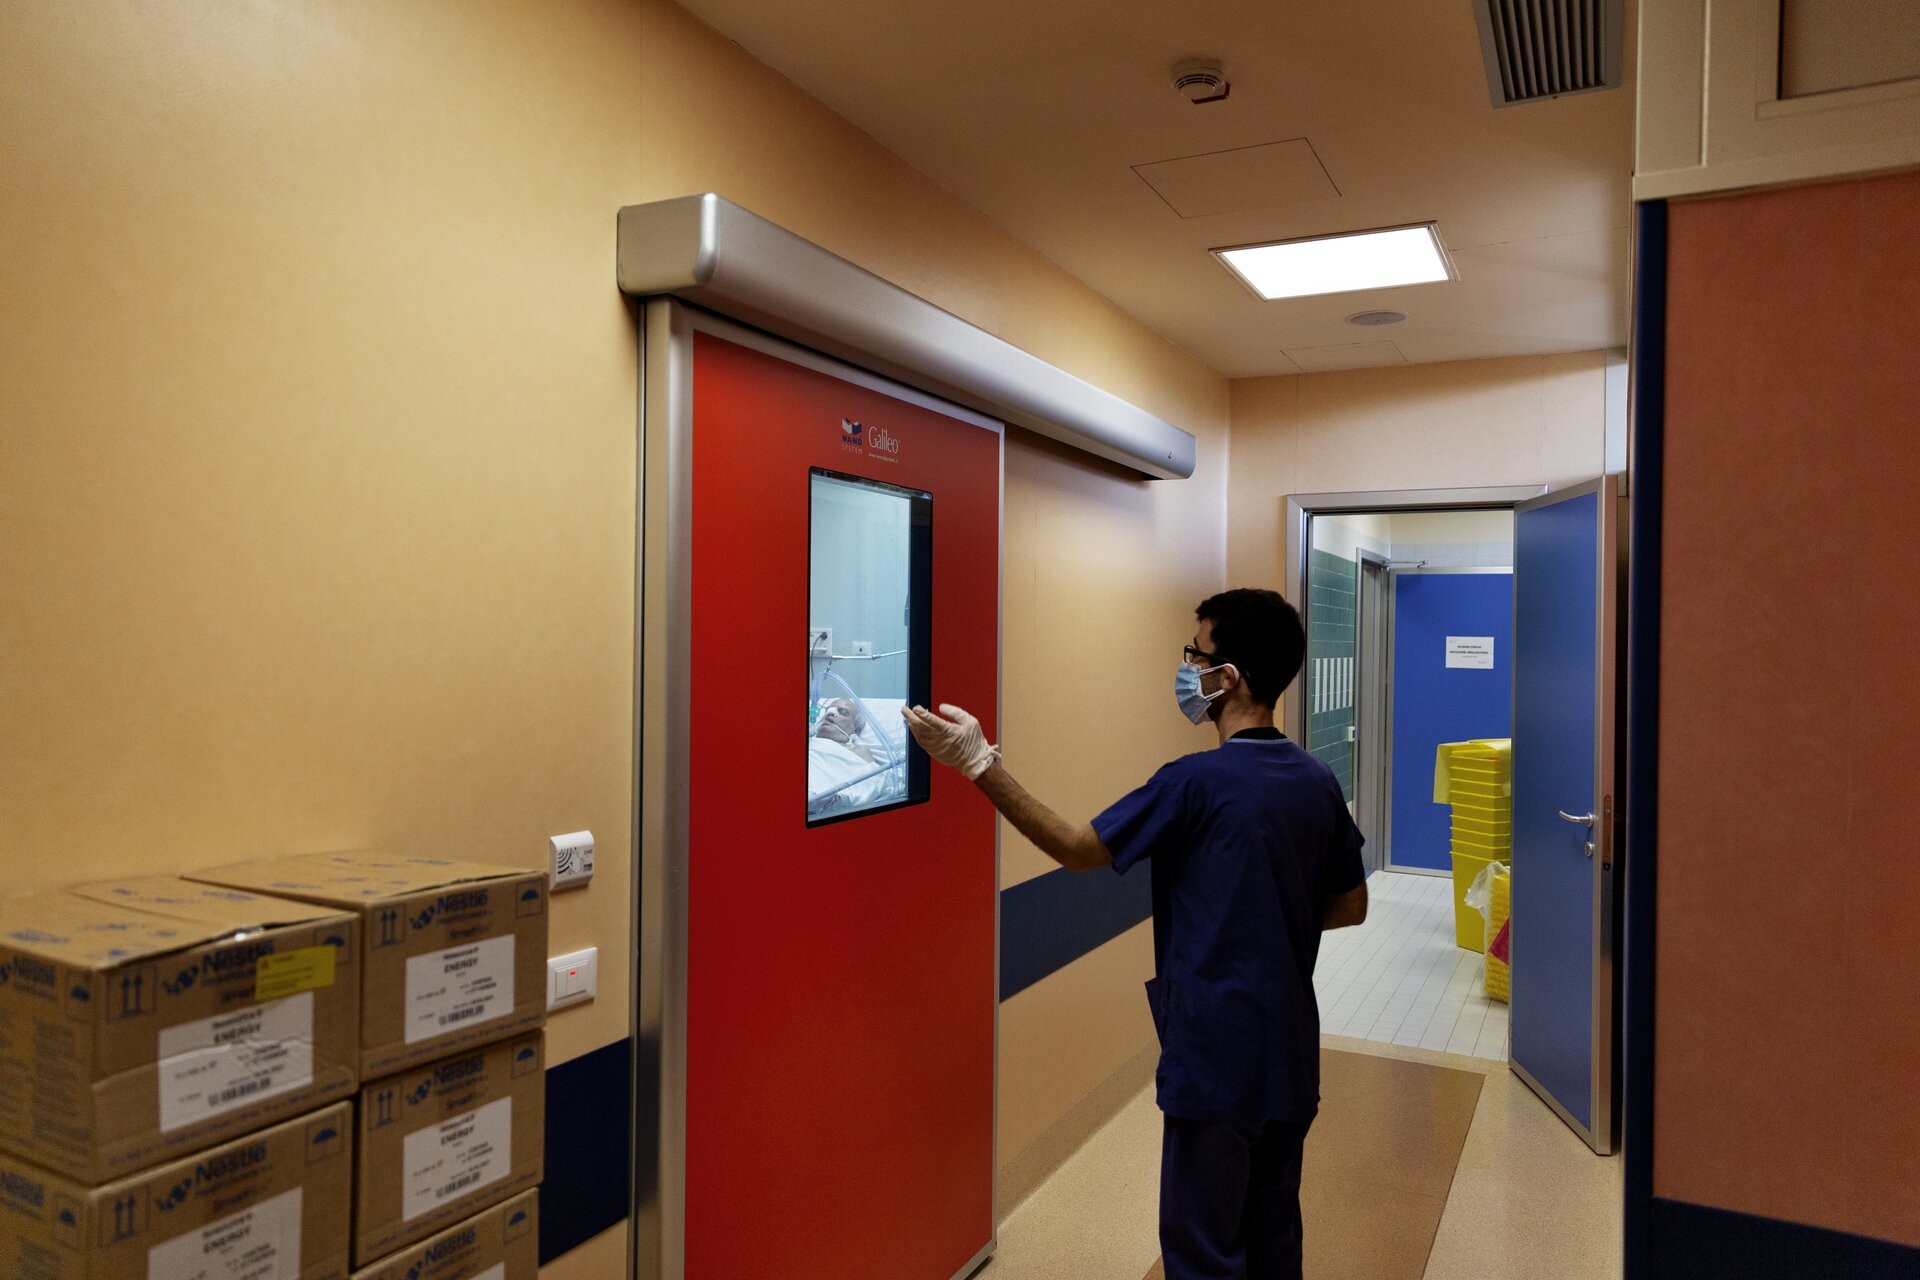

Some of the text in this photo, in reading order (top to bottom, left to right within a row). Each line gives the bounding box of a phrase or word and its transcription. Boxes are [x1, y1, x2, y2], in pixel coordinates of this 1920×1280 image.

[868, 426, 899, 454] Galileo
[436, 888, 489, 914] Nestlé
[444, 956, 479, 974] ENERGY
[213, 1022, 261, 1044] ENERGY
[432, 1053, 485, 1087] Nestlé
[440, 1125, 475, 1146] ENERGY
[194, 1140, 268, 1185] Nestlé
[202, 1226, 250, 1254] ENERGY
[424, 1226, 476, 1267] Nestlé
